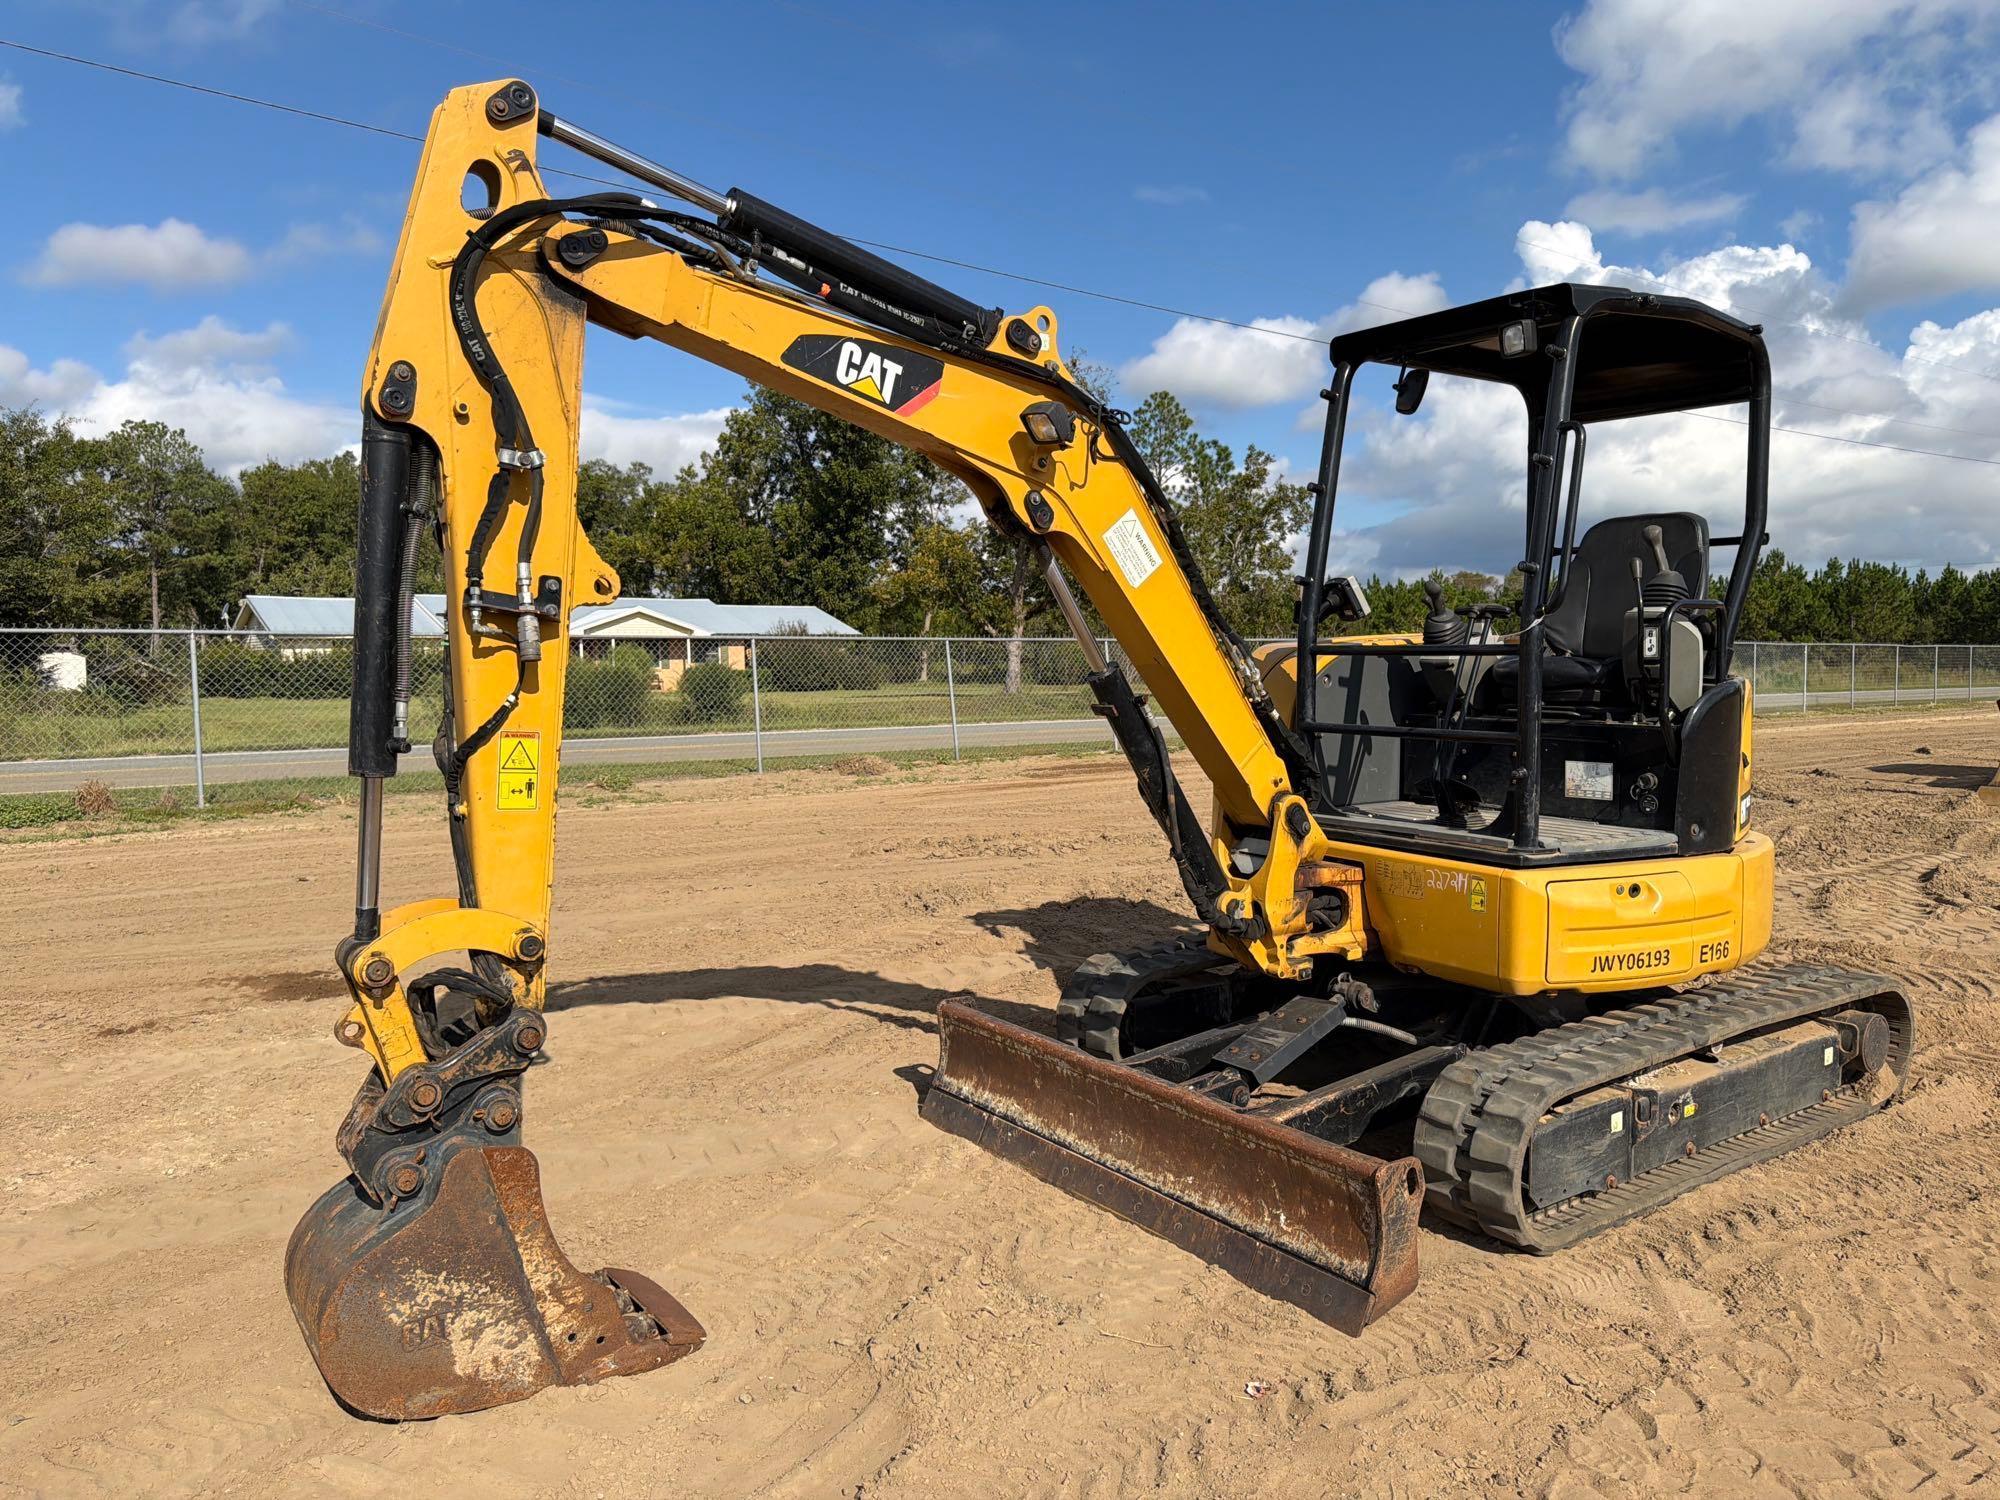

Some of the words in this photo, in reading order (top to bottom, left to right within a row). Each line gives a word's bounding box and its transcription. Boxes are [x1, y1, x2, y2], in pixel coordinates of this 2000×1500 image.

[840, 282, 860, 297] CAT
[467, 340, 486, 361] CAT
[836, 341, 904, 405] CAT
[1134, 531, 1157, 567] WARNING
[1590, 949, 1671, 974] JWY06193
[1699, 940, 1730, 964] E166
